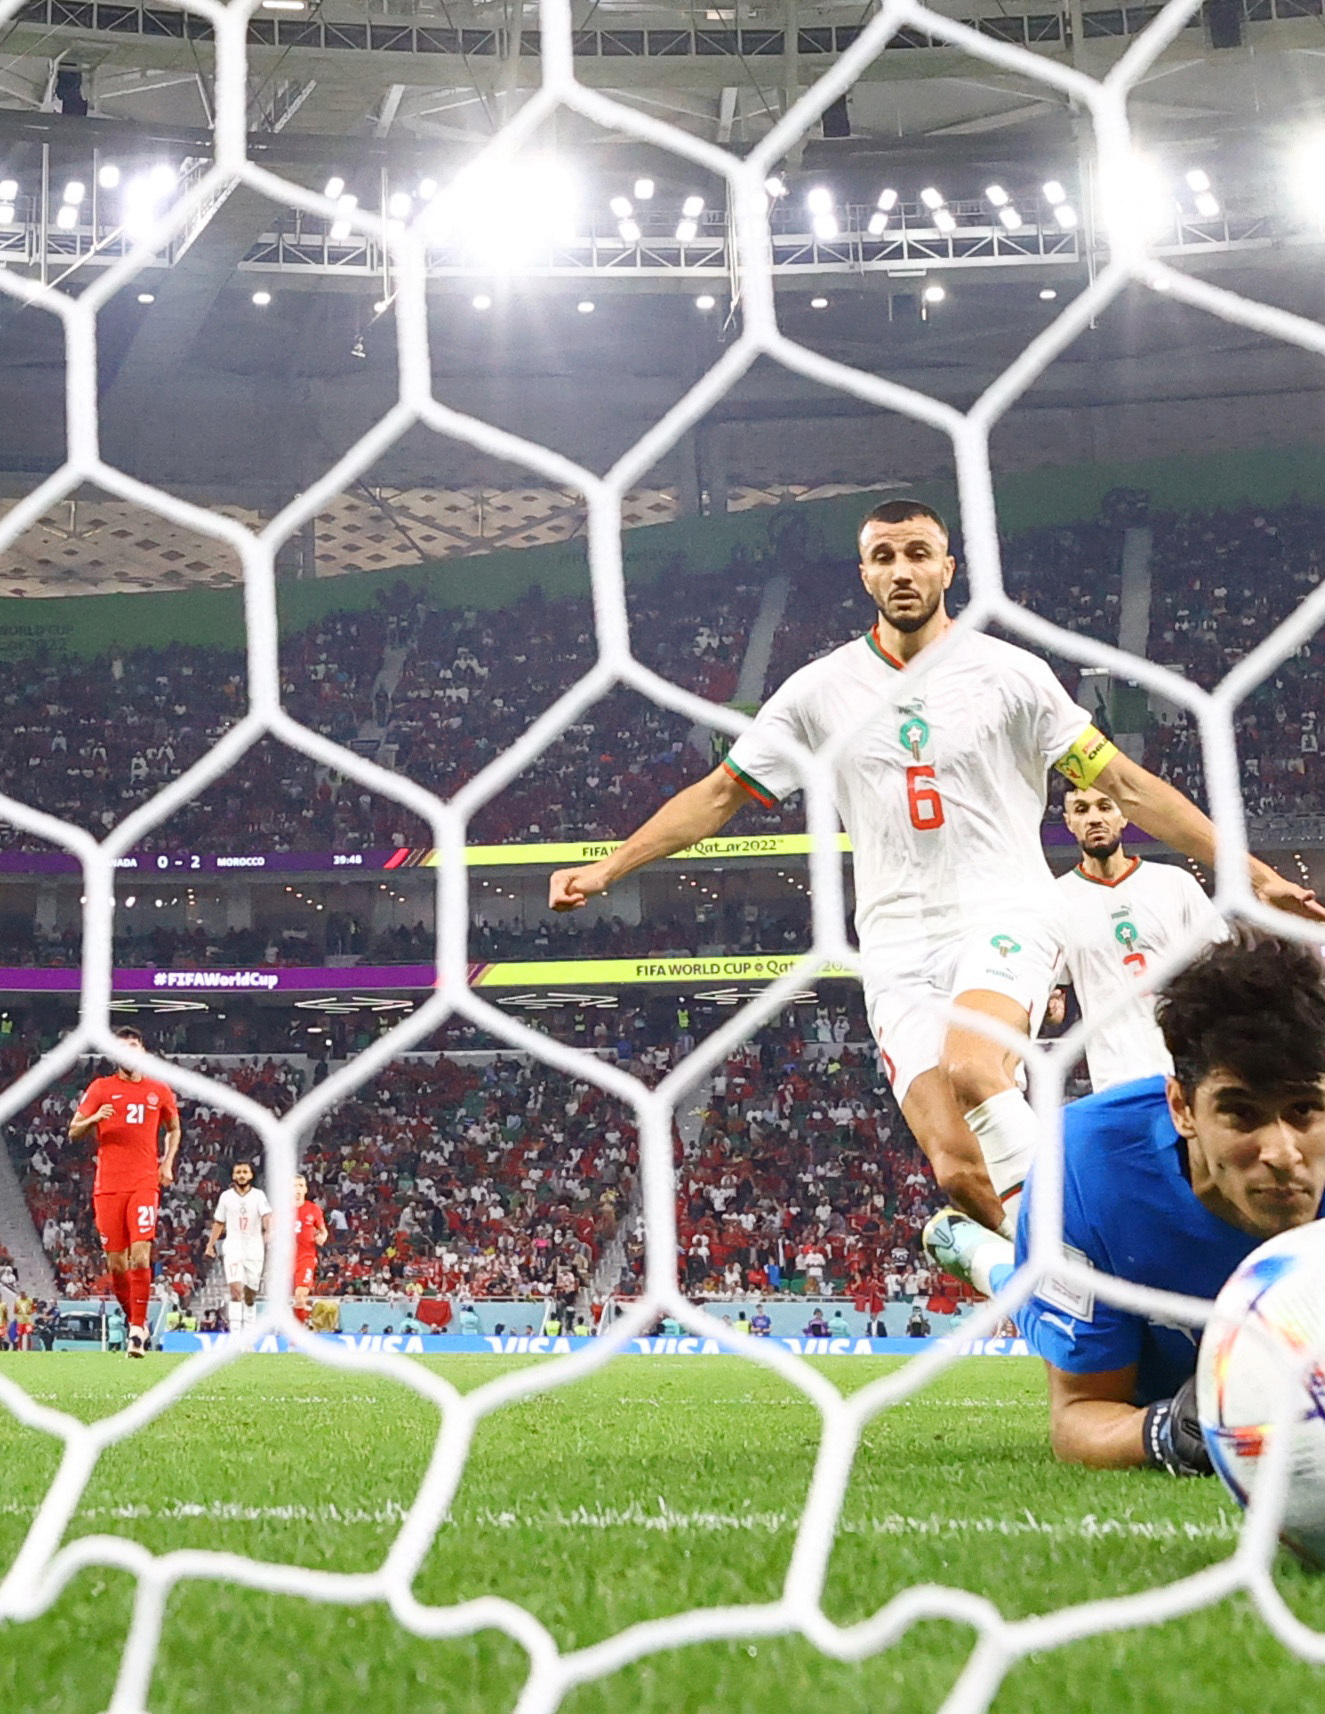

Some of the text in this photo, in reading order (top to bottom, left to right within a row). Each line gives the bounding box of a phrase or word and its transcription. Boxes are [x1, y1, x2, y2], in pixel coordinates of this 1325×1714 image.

[906, 765, 945, 831] 6
[582, 846, 609, 857] FIFA
[157, 855, 169, 869] 0
[190, 855, 201, 869] 2
[216, 856, 266, 867] MOROCCO
[636, 964, 666, 976] FIFA
[669, 962, 720, 976] WORLD
[723, 961, 751, 975] CUP
[153, 971, 279, 990] #FIFAWorldCup
[125, 1103, 145, 1125] 21
[137, 1206, 155, 1227] 21
[195, 1333, 280, 1353] VA
[338, 1334, 425, 1354] VISA
[484, 1336, 571, 1354] VISA
[632, 1337, 721, 1355] VISA
[782, 1338, 874, 1356] VISA
